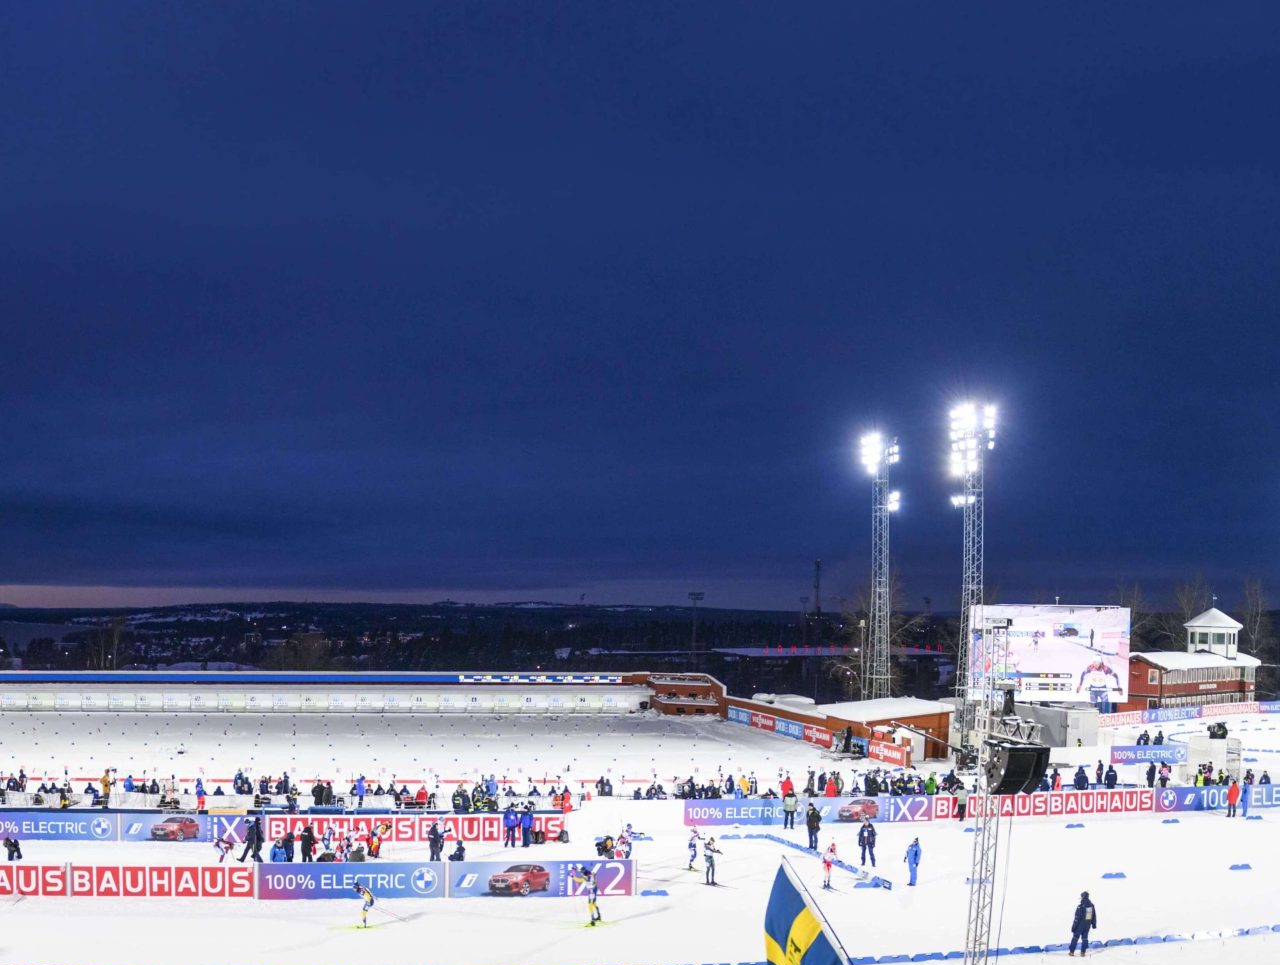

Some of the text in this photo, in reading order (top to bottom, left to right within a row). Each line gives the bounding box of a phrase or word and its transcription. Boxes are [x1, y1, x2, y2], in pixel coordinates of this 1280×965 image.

[1114, 750, 1174, 760] 100% ELECTRIC
[889, 797, 929, 821] iX2
[1051, 792, 1151, 811] BAUHAUS
[687, 806, 784, 820] 100% ELECTRIC
[22, 821, 87, 835] ELECTRIC
[73, 870, 251, 893] BAUHAUS
[265, 873, 405, 890] 100% ELECTRIC
